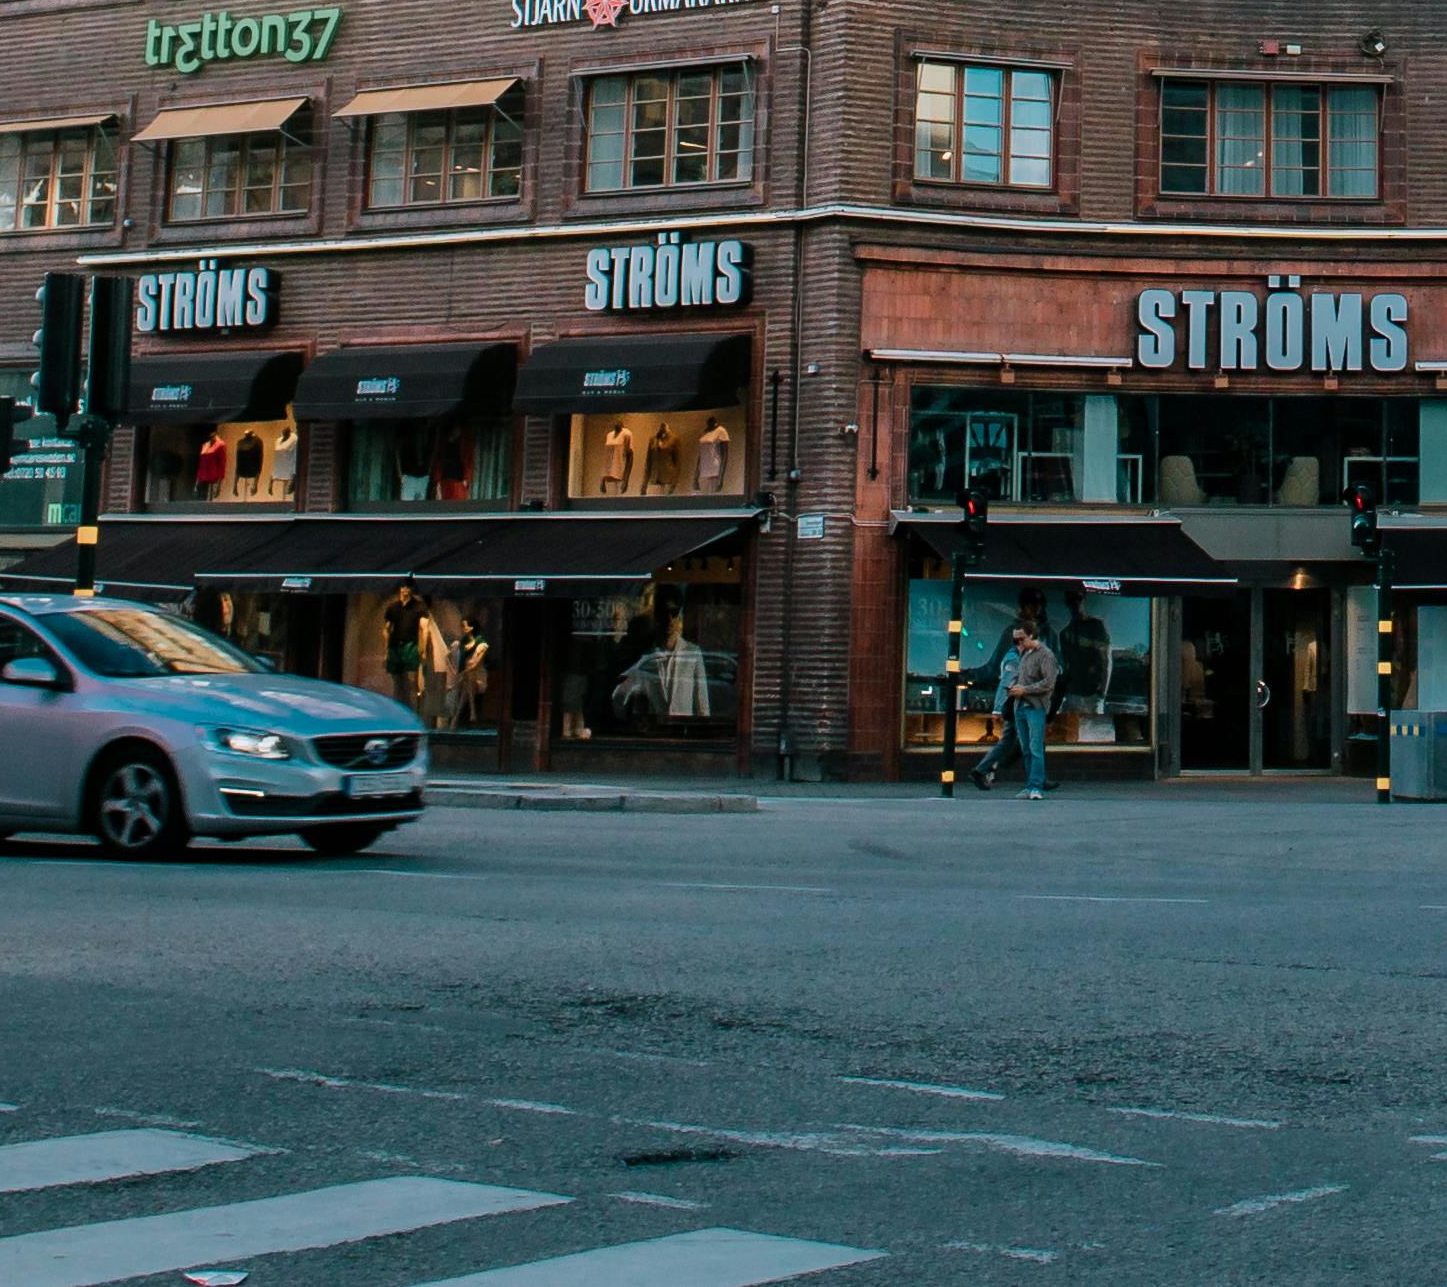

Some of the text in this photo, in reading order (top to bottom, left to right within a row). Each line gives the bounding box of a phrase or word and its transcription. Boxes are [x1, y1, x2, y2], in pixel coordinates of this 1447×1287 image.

[136, 259, 269, 333] STRÖMS
[584, 232, 743, 312] STRÖMS
[1137, 274, 1409, 372] STRÖMS
